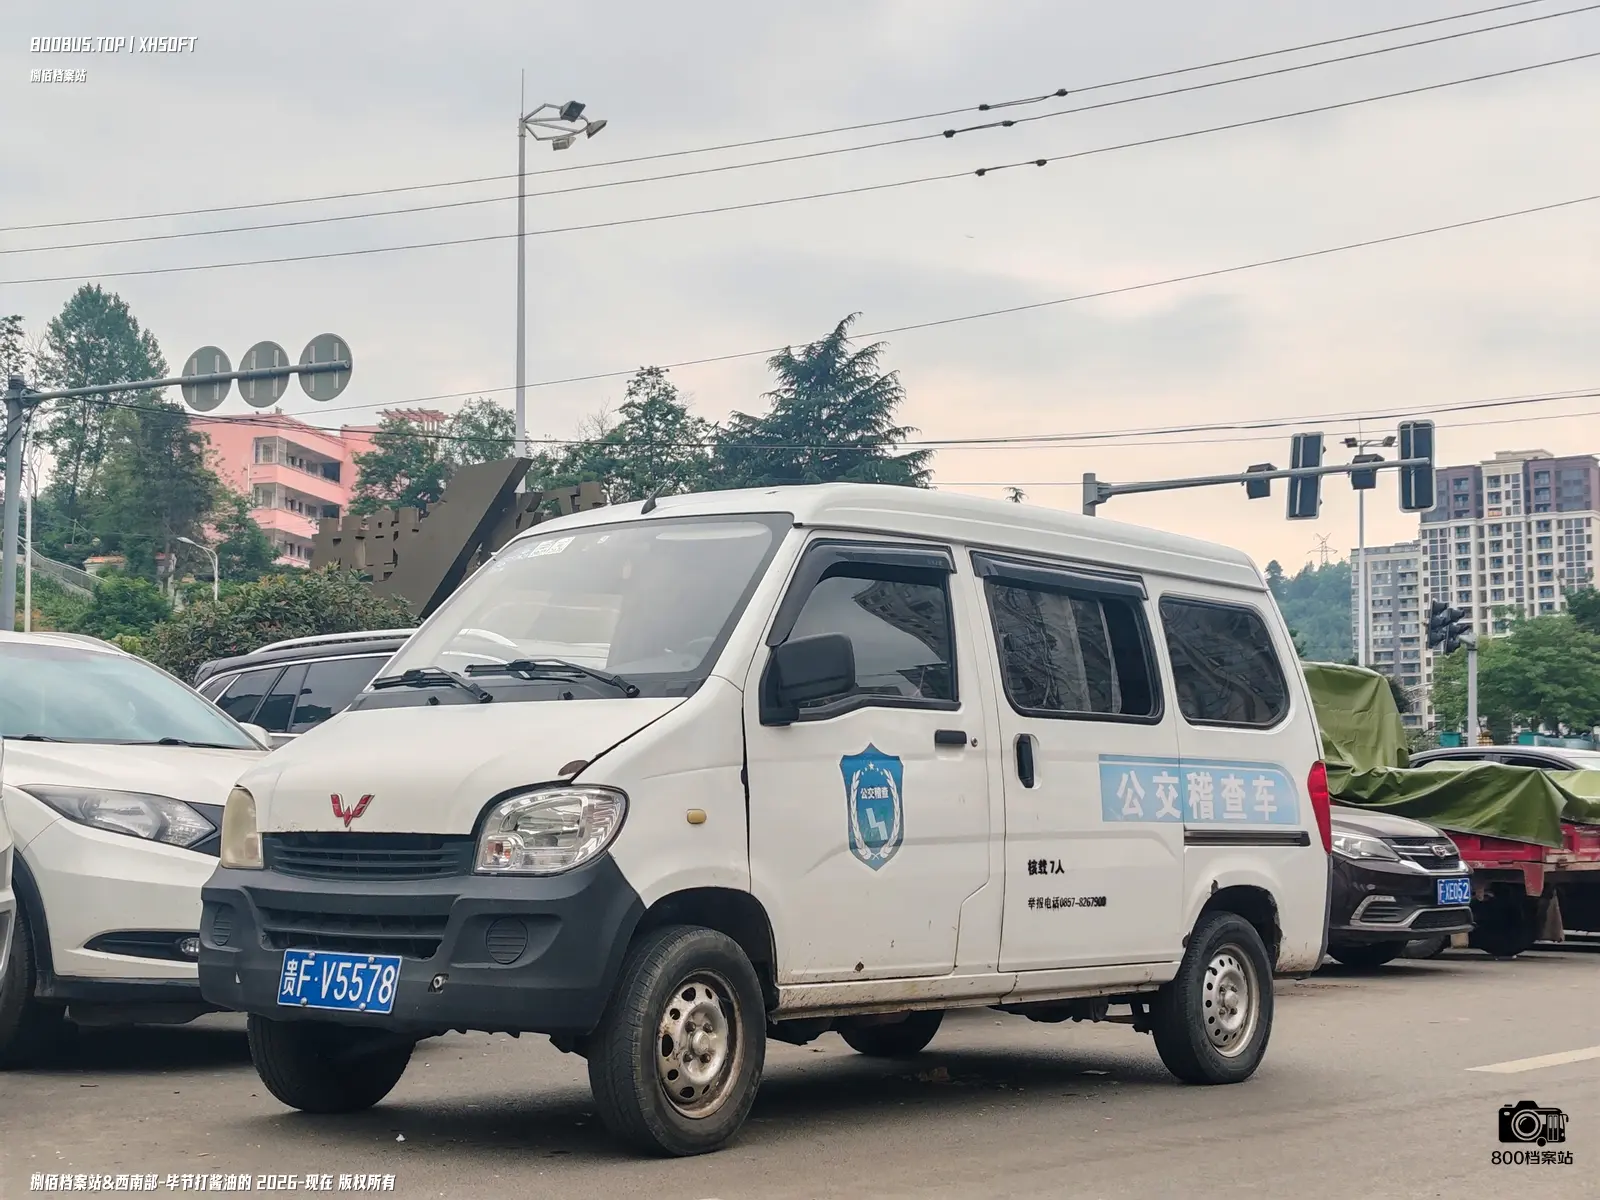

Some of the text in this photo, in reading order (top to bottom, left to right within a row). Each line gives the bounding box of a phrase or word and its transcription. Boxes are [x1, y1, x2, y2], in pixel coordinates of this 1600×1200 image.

[860, 786, 889, 799] 公交稽查
[1116, 770, 1278, 820] 公交稽查车
